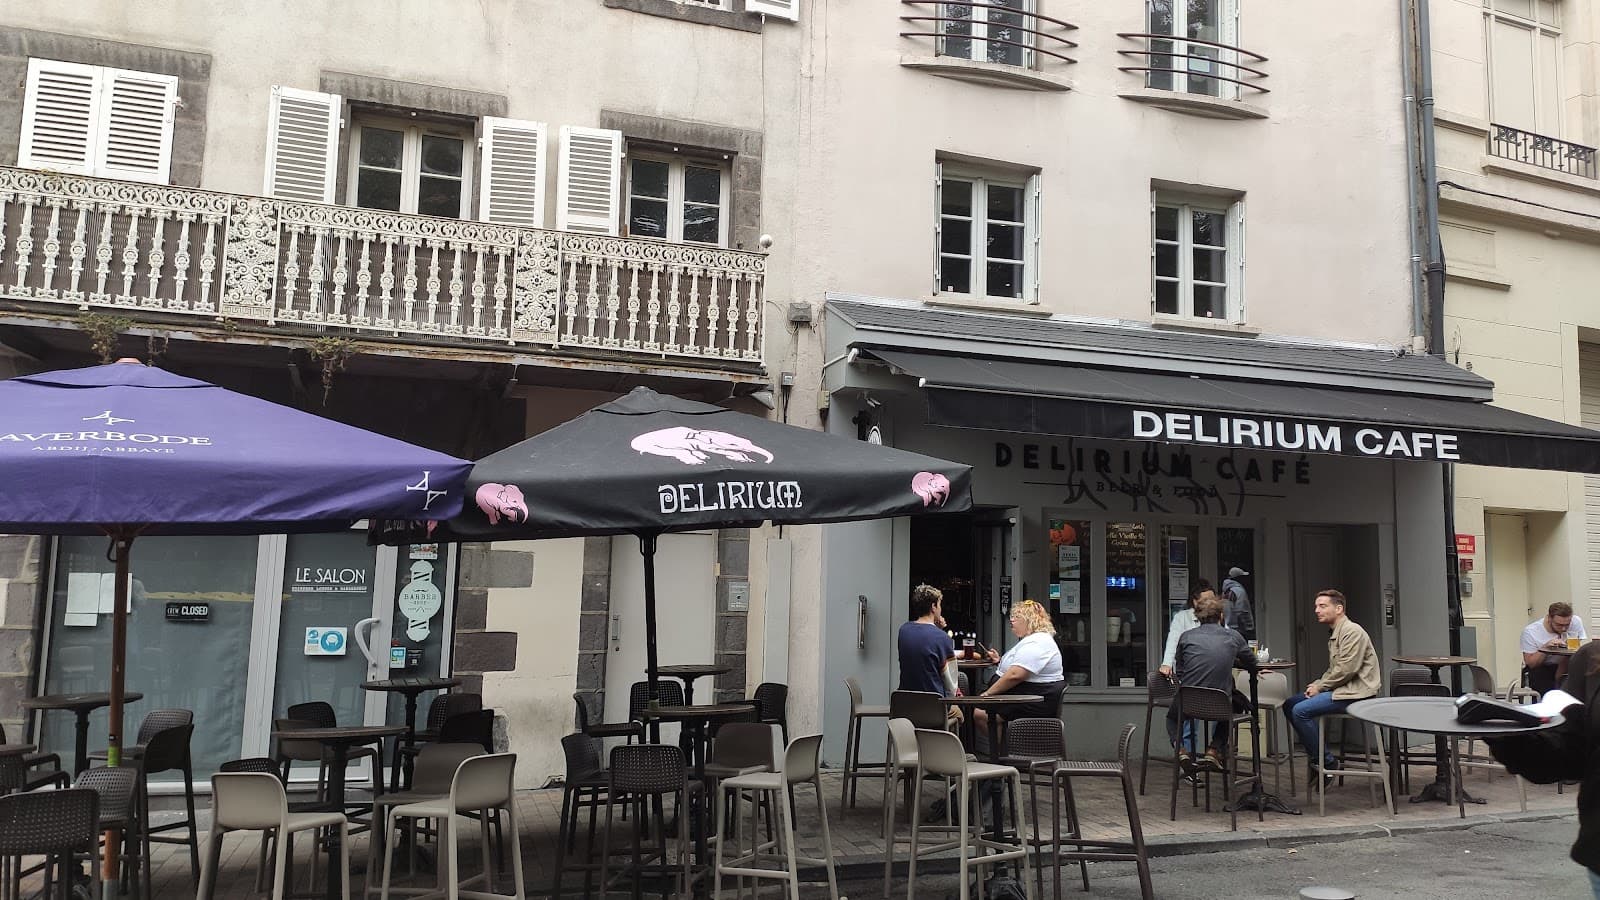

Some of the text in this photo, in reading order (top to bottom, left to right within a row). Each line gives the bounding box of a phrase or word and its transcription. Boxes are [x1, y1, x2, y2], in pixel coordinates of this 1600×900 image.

[0, 431, 212, 445] AVERBODE
[1132, 410, 1460, 460] DELIRIUM CAFE
[995, 442, 1311, 484] DELIRIUM CAFÉ
[658, 481, 802, 514] DELIRIUM
[296, 567, 366, 584] LE SALON
[181, 605, 208, 616] CLOSED
